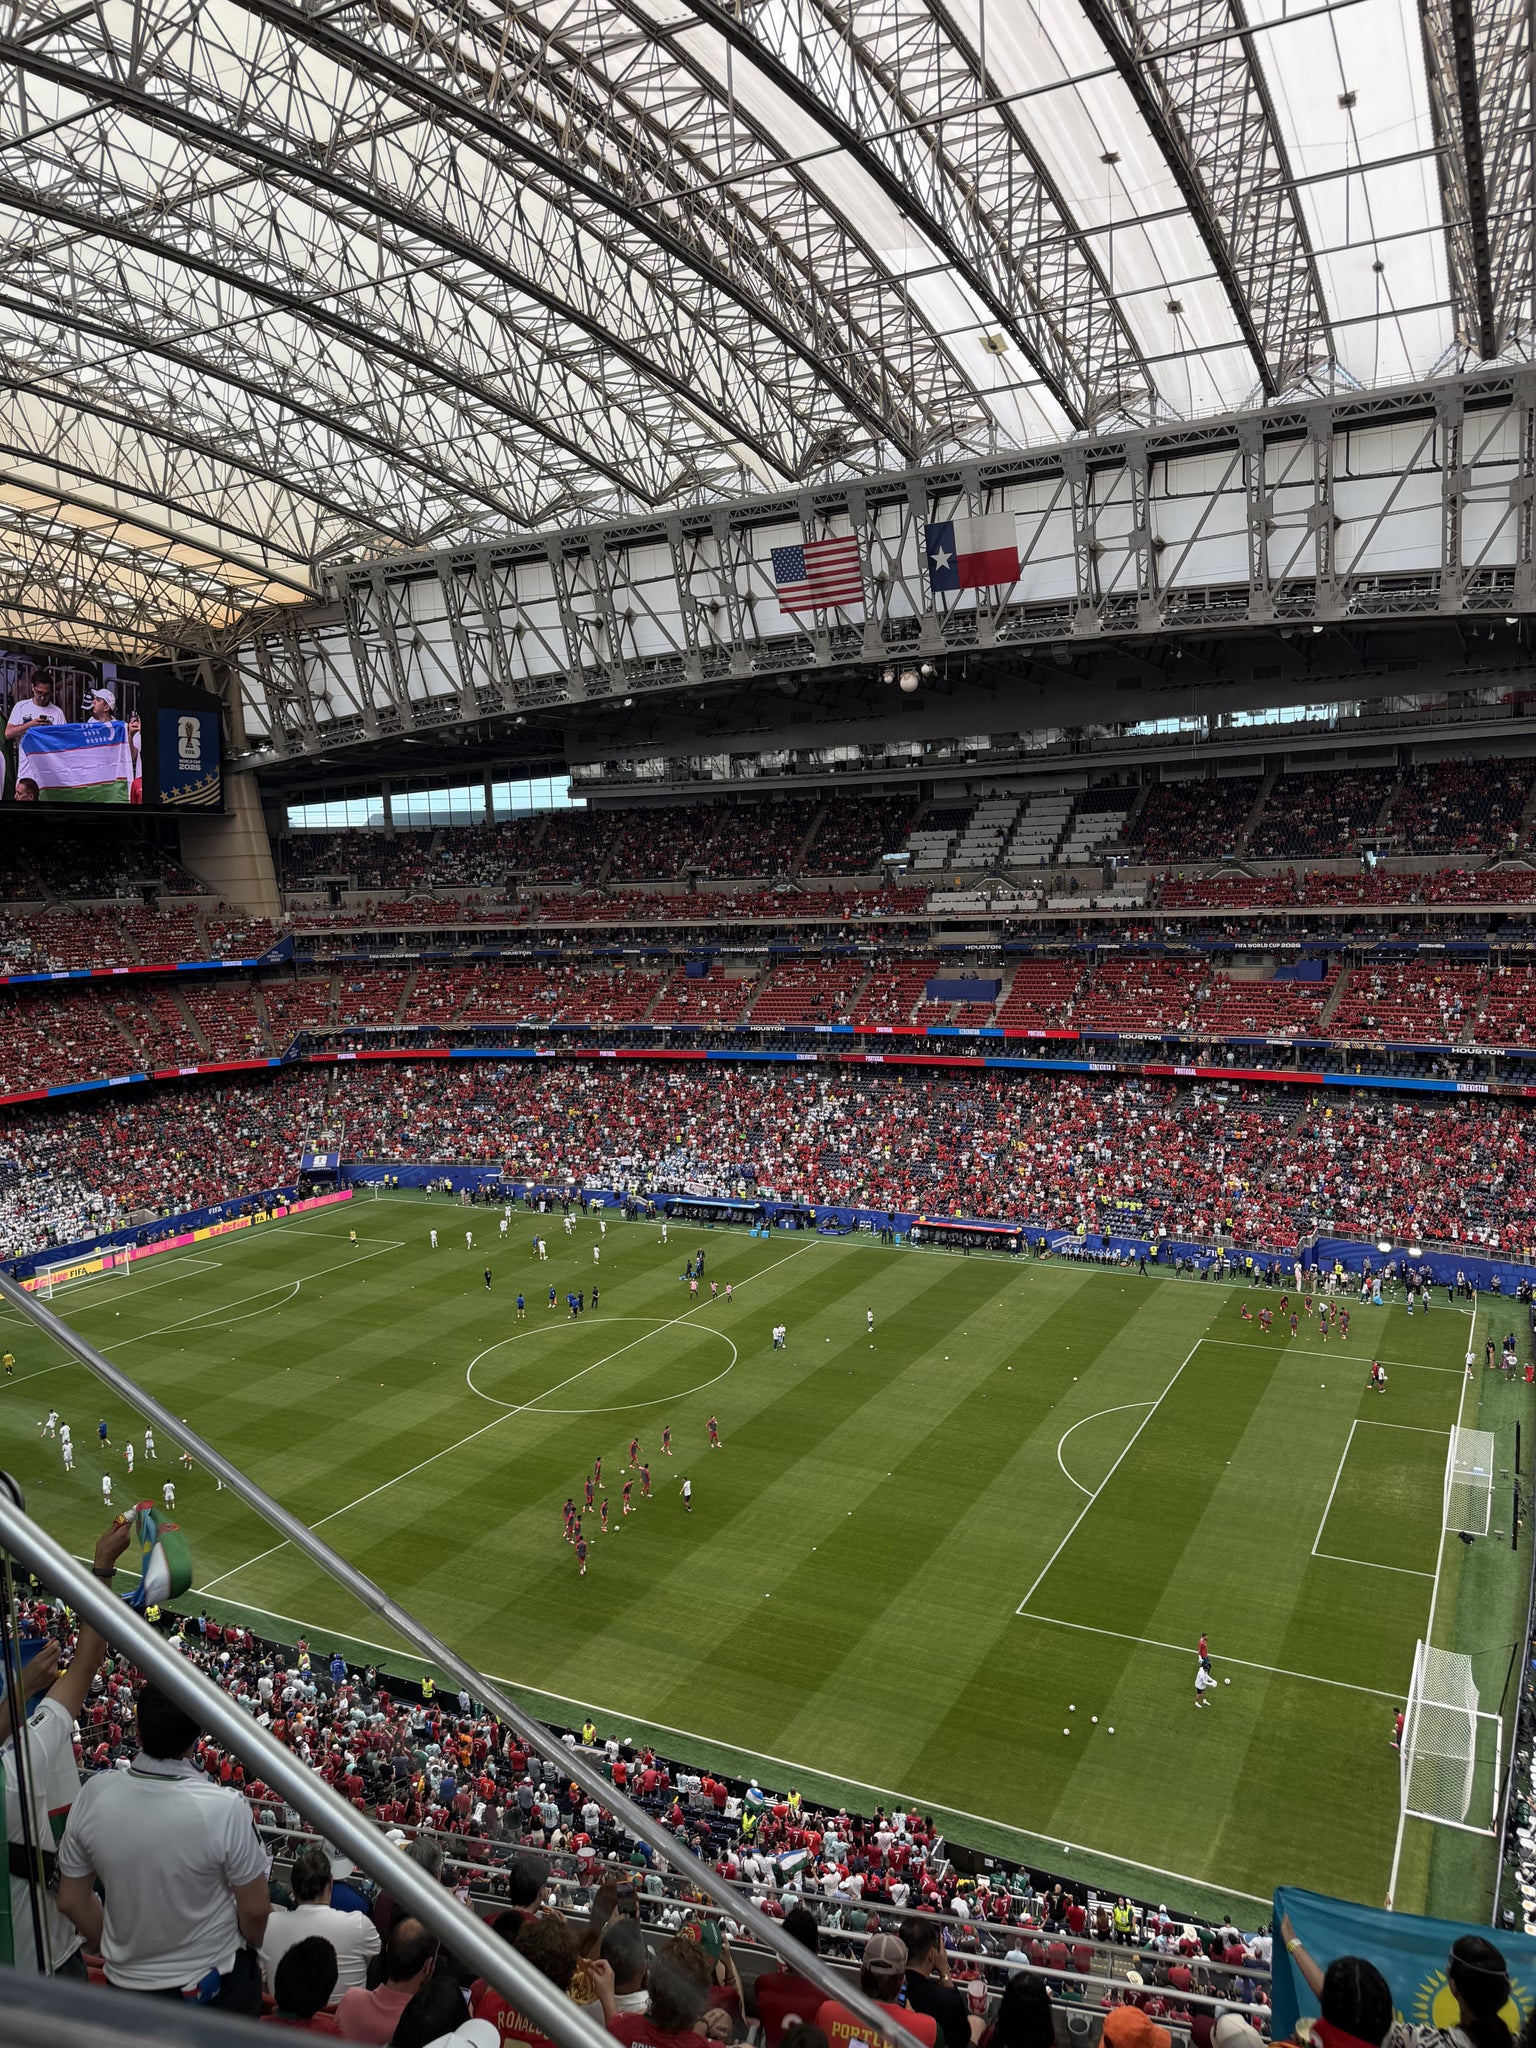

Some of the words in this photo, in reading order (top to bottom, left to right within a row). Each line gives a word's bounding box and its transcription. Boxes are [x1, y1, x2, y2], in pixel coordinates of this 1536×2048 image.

[179, 763, 201, 771] 2026
[1451, 1047, 1505, 1055] HOUSTON
[1174, 1067, 1197, 1076] PORTUGAL
[1456, 1083, 1489, 1093] UZBEKISTAN
[208, 1206, 222, 1215] FIFA
[70, 1267, 87, 1277] FIFA
